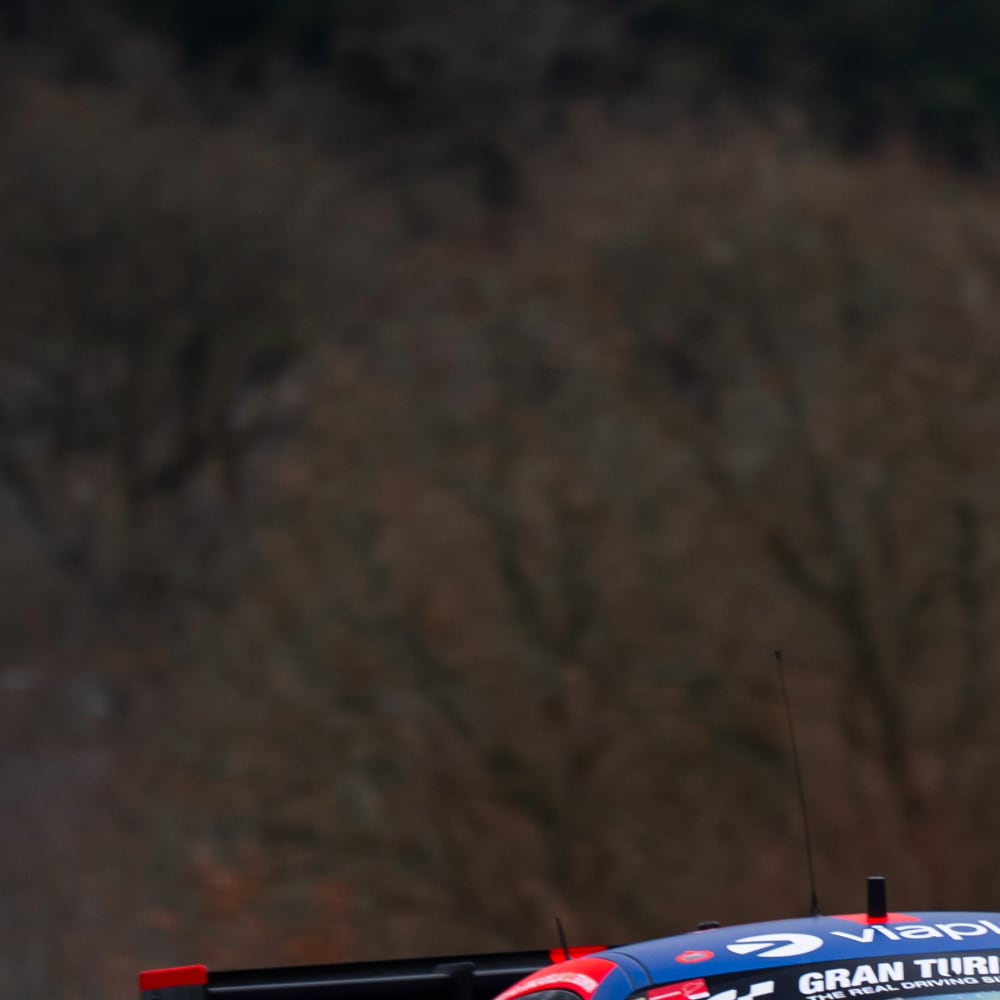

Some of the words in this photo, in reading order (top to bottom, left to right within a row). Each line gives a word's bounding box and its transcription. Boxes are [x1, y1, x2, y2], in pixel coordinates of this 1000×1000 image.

[799, 961, 905, 995] GRAN
[850, 984, 900, 998] REAL
[902, 976, 980, 990] DRIVING
